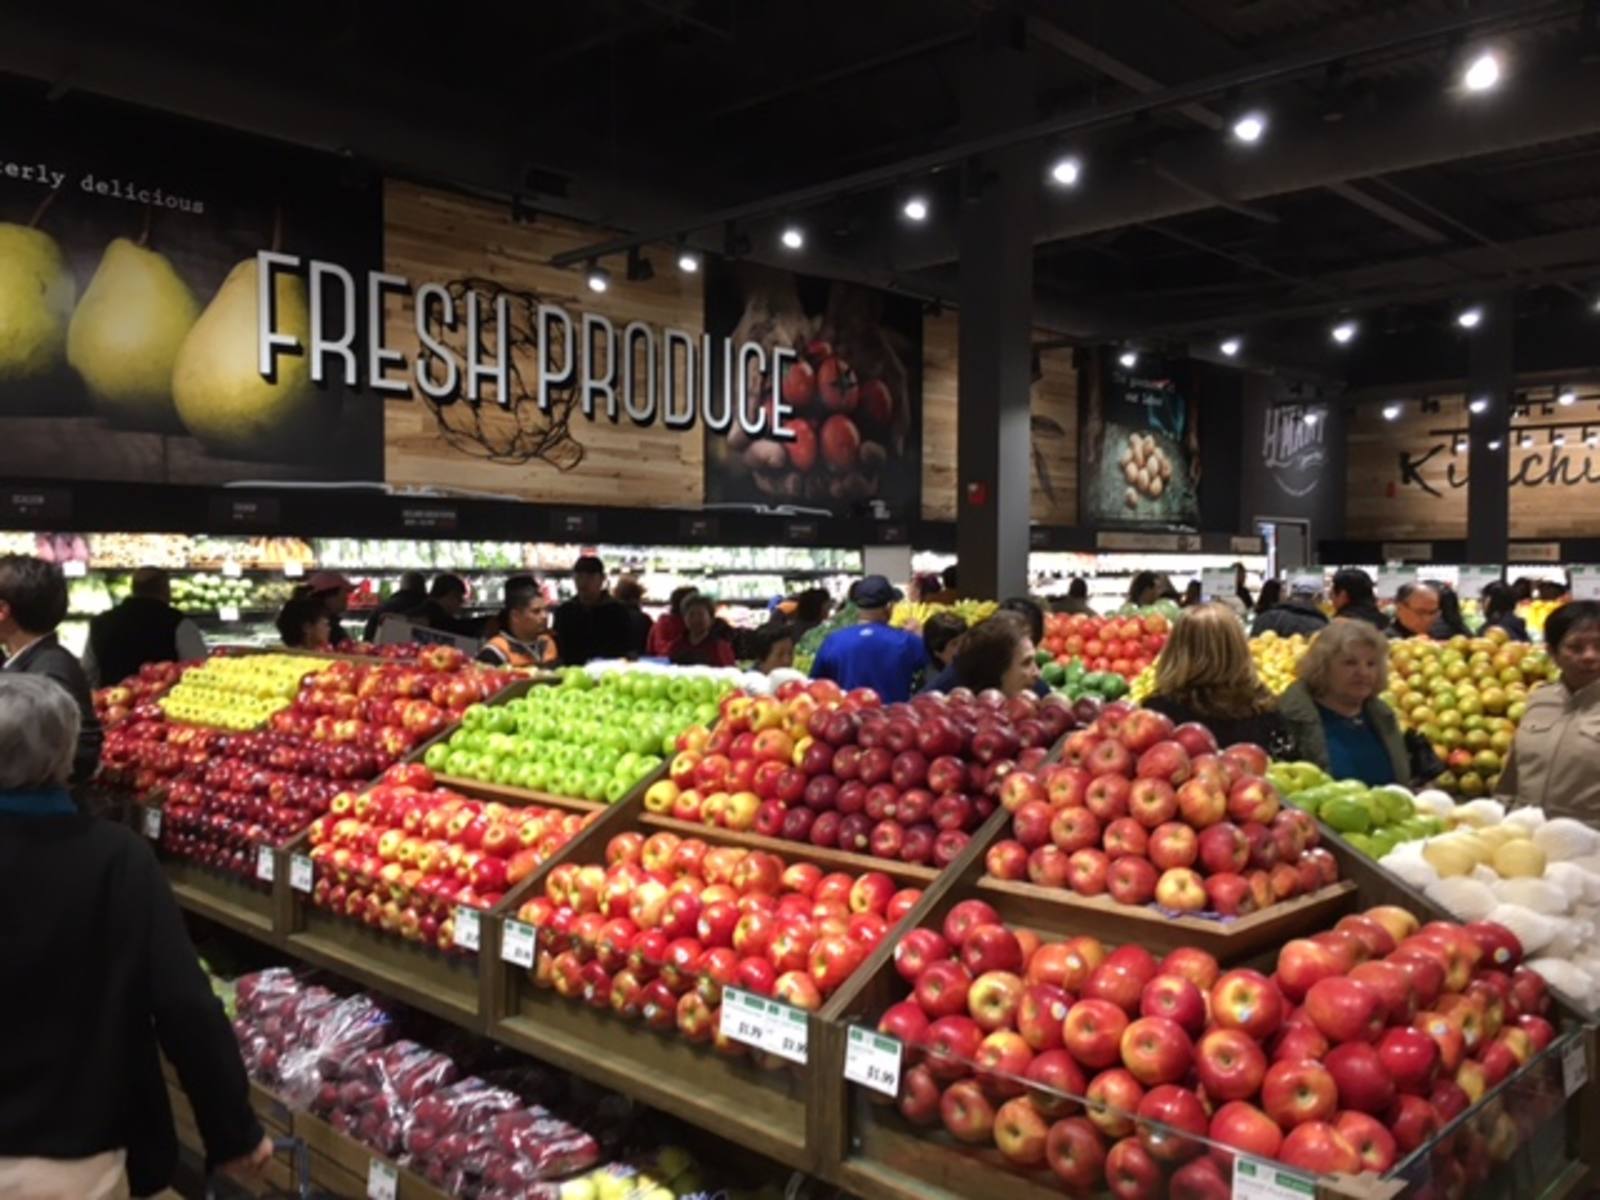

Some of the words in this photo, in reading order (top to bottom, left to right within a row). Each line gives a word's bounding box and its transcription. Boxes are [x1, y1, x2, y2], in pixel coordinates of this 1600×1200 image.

[0, 162, 66, 189] erly
[80, 173, 204, 214] delicious
[257, 250, 507, 404] FRESH
[537, 304, 797, 437] PRODUCE
[1400, 444, 1600, 498] Kichi
